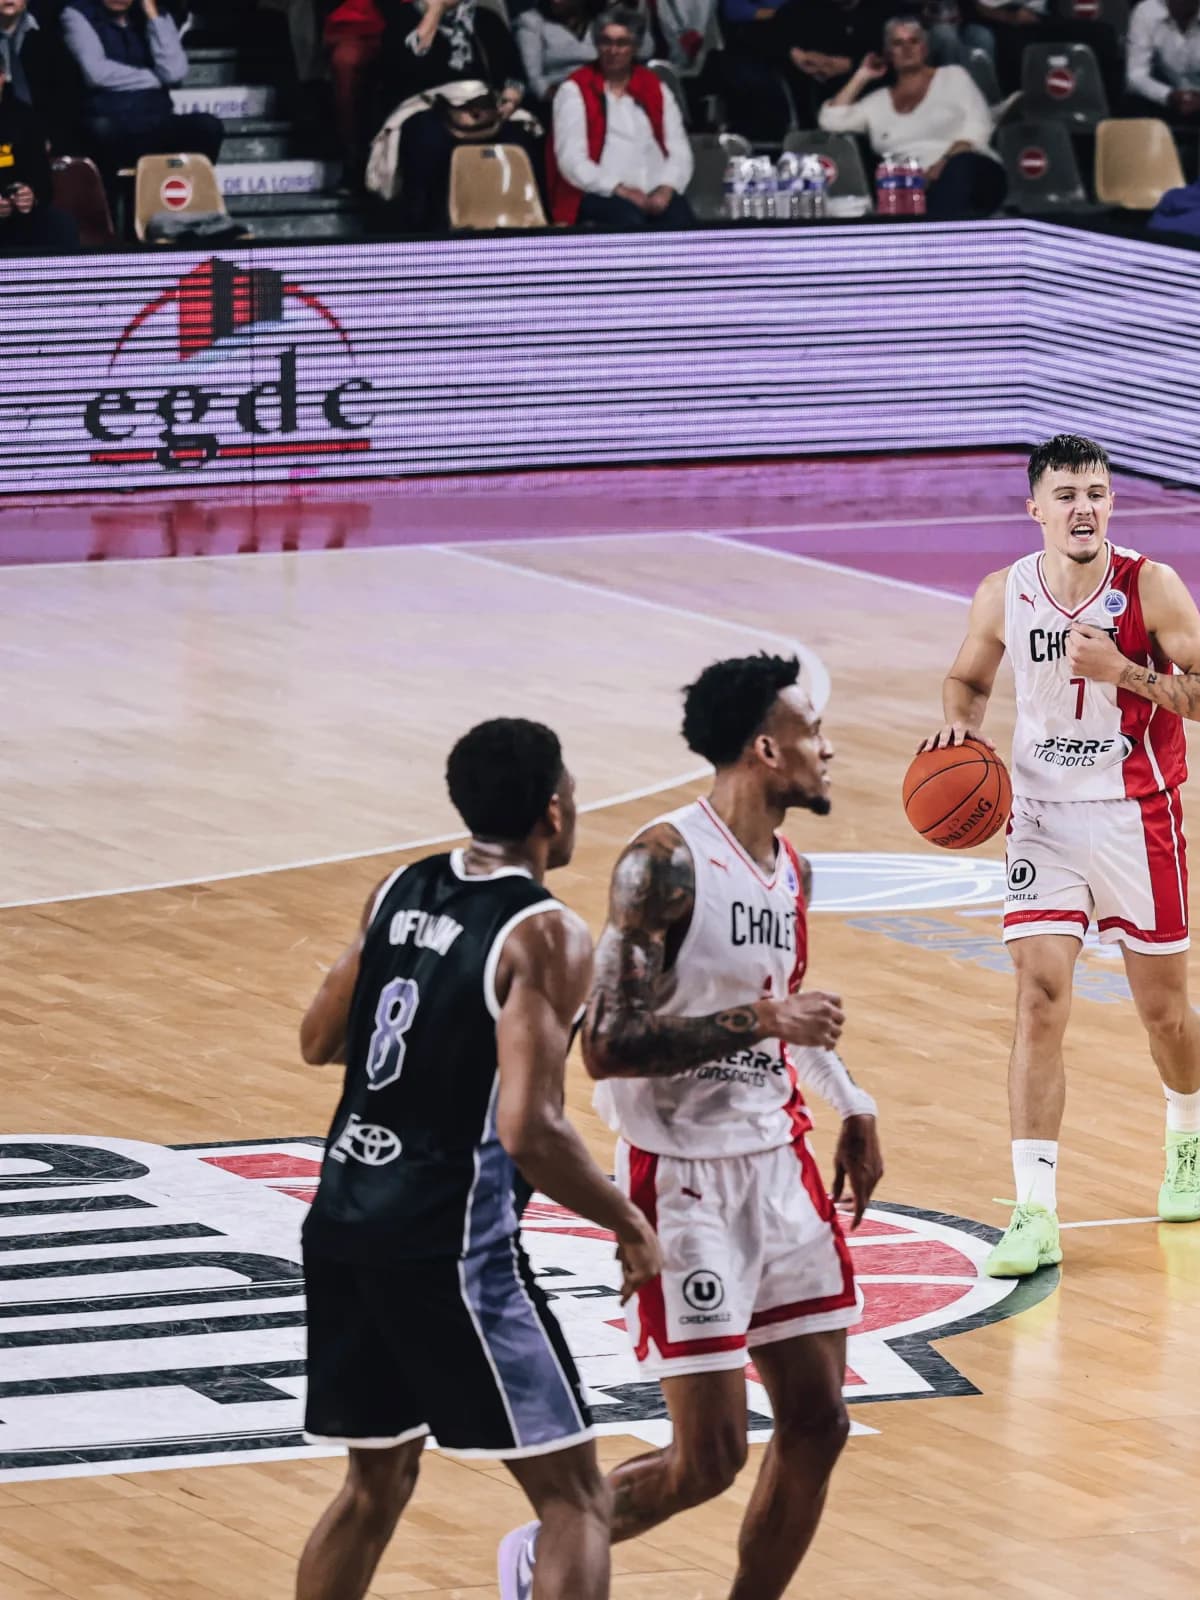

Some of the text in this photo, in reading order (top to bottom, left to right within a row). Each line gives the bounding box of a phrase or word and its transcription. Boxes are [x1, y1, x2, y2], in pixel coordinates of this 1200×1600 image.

[250, 177, 268, 190] LA
[84, 345, 375, 470] egdc
[1069, 678, 1086, 721] 7
[366, 976, 420, 1091] 8
